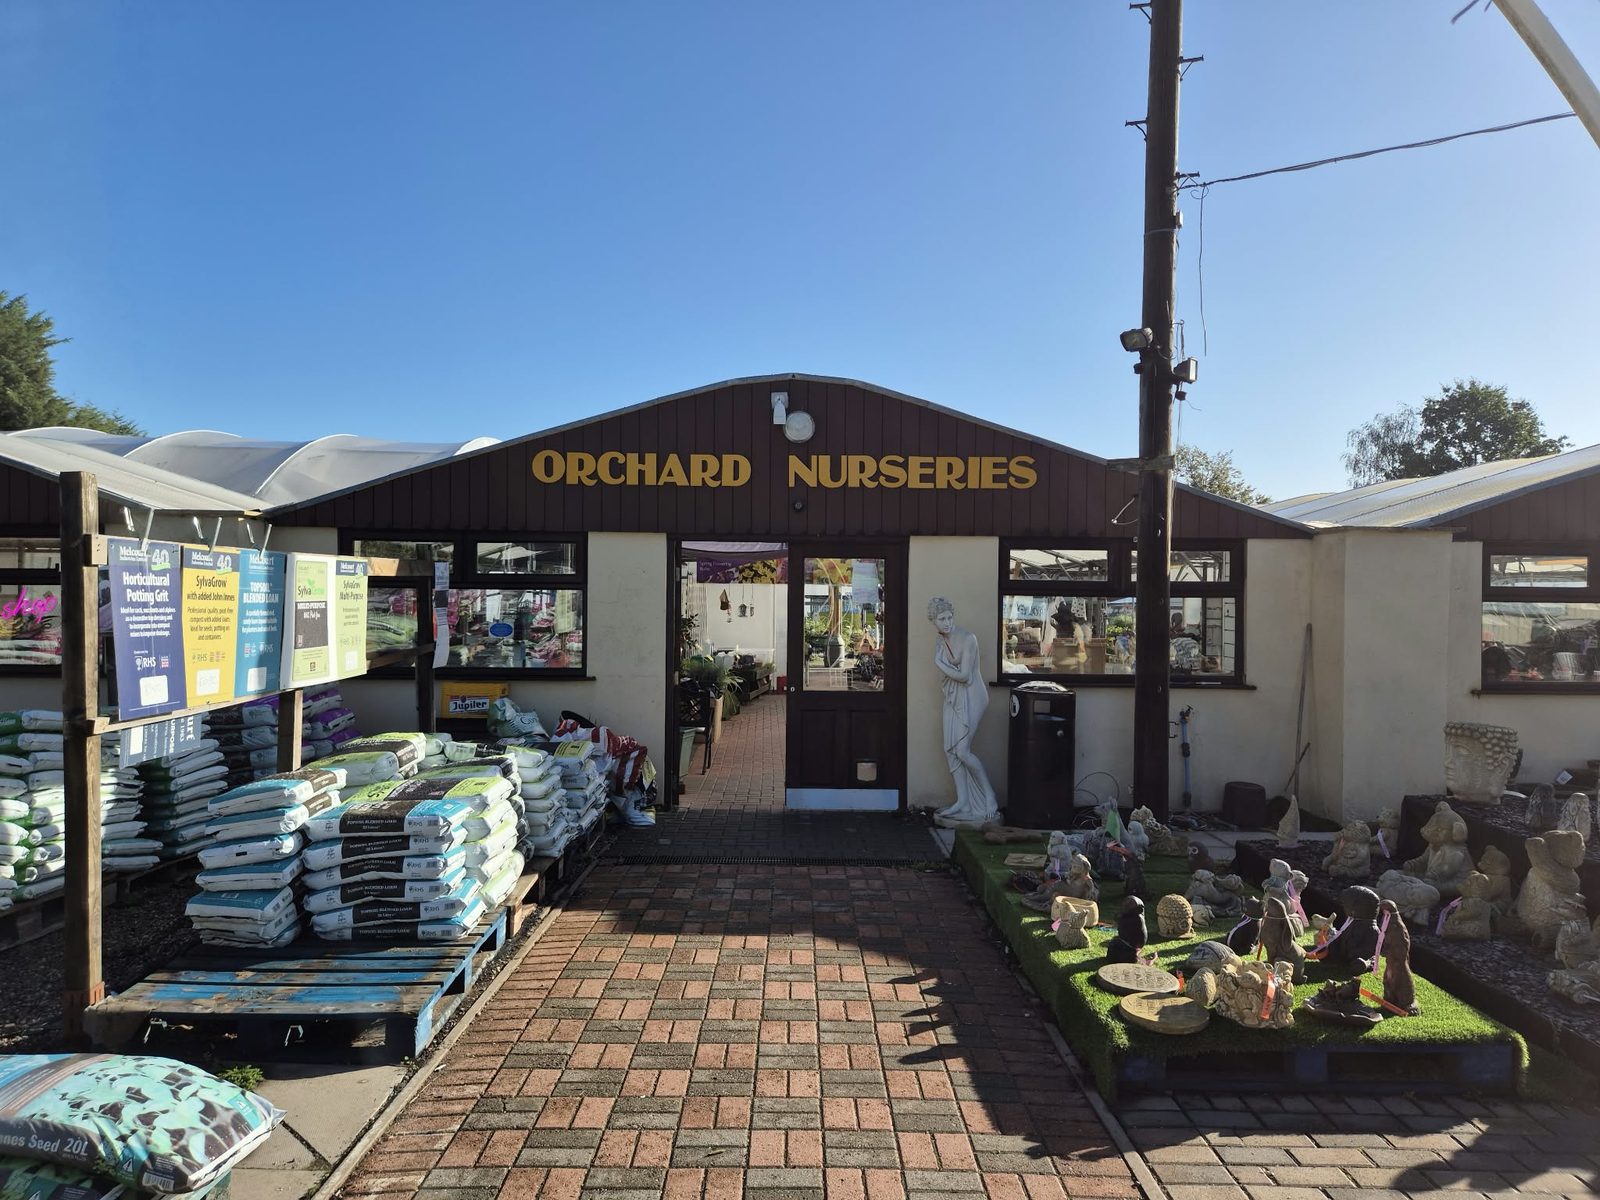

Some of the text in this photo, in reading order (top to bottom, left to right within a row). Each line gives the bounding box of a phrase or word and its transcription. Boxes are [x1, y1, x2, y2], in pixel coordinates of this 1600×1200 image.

[531, 449, 1038, 491] ORCHARD NURSERIES
[122, 571, 170, 586] Horticultural
[195, 575, 227, 590] SylvaGrow
[126, 588, 169, 605] Potting Grit
[197, 592, 212, 601] added
[212, 592, 223, 601] John
[142, 656, 157, 668] RHS
[452, 700, 488, 711] Jupiler
[28, 1134, 61, 1153] Seed
[63, 1137, 89, 1156] 20L
